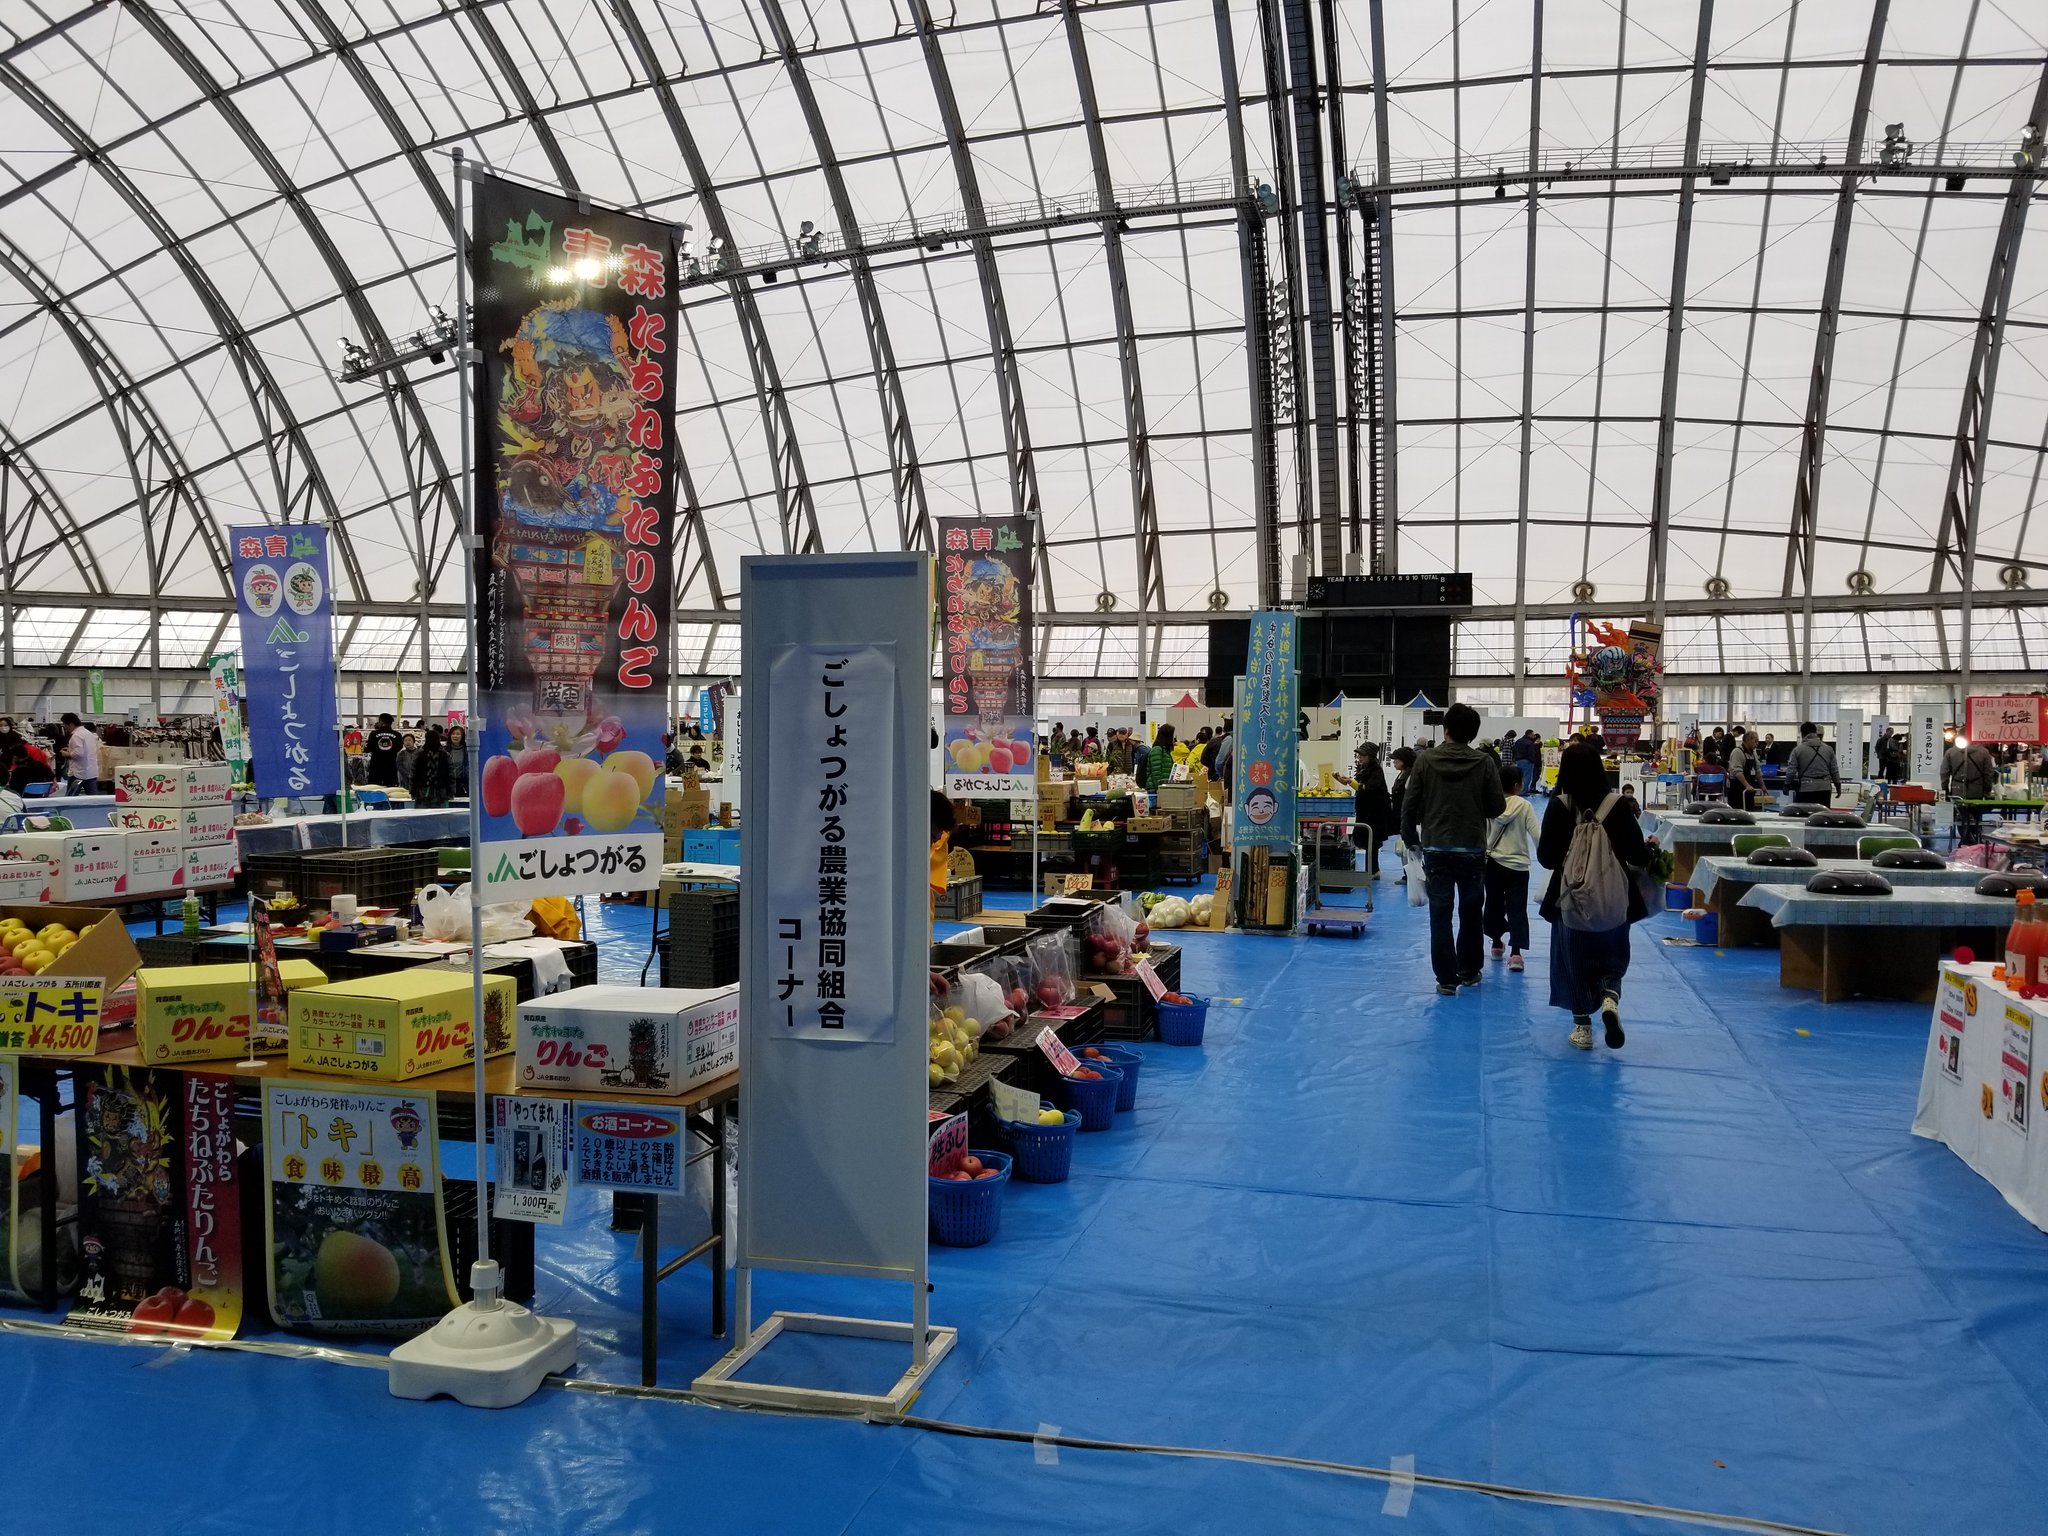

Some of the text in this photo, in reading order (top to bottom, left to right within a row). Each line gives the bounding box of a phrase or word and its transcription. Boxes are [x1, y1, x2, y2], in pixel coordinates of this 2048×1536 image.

[617, 305, 668, 690] たちねぷたりんご
[147, 777, 177, 796] りんご
[816, 659, 849, 1031] ごしょつがる農業協同組合
[519, 843, 647, 882] ごしょつがる
[2, 980, 103, 989] JAごしょつがる 五所川原産
[777, 917, 805, 1029] コーナー
[24, 991, 99, 1024] トキ
[27, 1024, 95, 1051] ¥4,500
[171, 1014, 251, 1043] りんご
[318, 1032, 344, 1049] トキ
[415, 1022, 471, 1057] りんご
[317, 1055, 379, 1072] JAごしょつがる
[536, 1039, 609, 1068] りんご
[699, 1051, 734, 1075] JAごしょつがる
[275, 1093, 387, 1113] ごしょがわら発祥のりんご
[508, 1100, 560, 1126] 「やってまれ」
[213, 1081, 233, 1182] ごしょがわら
[281, 1111, 374, 1157] 「トキ」
[591, 1115, 669, 1134] お酒コーナー
[187, 1077, 219, 1287] たちねぷたりんご
[286, 1157, 422, 1190] 食味最高
[581, 1168, 675, 1187] 酒類を販売しません
[512, 1195, 548, 1210] 1,300円
